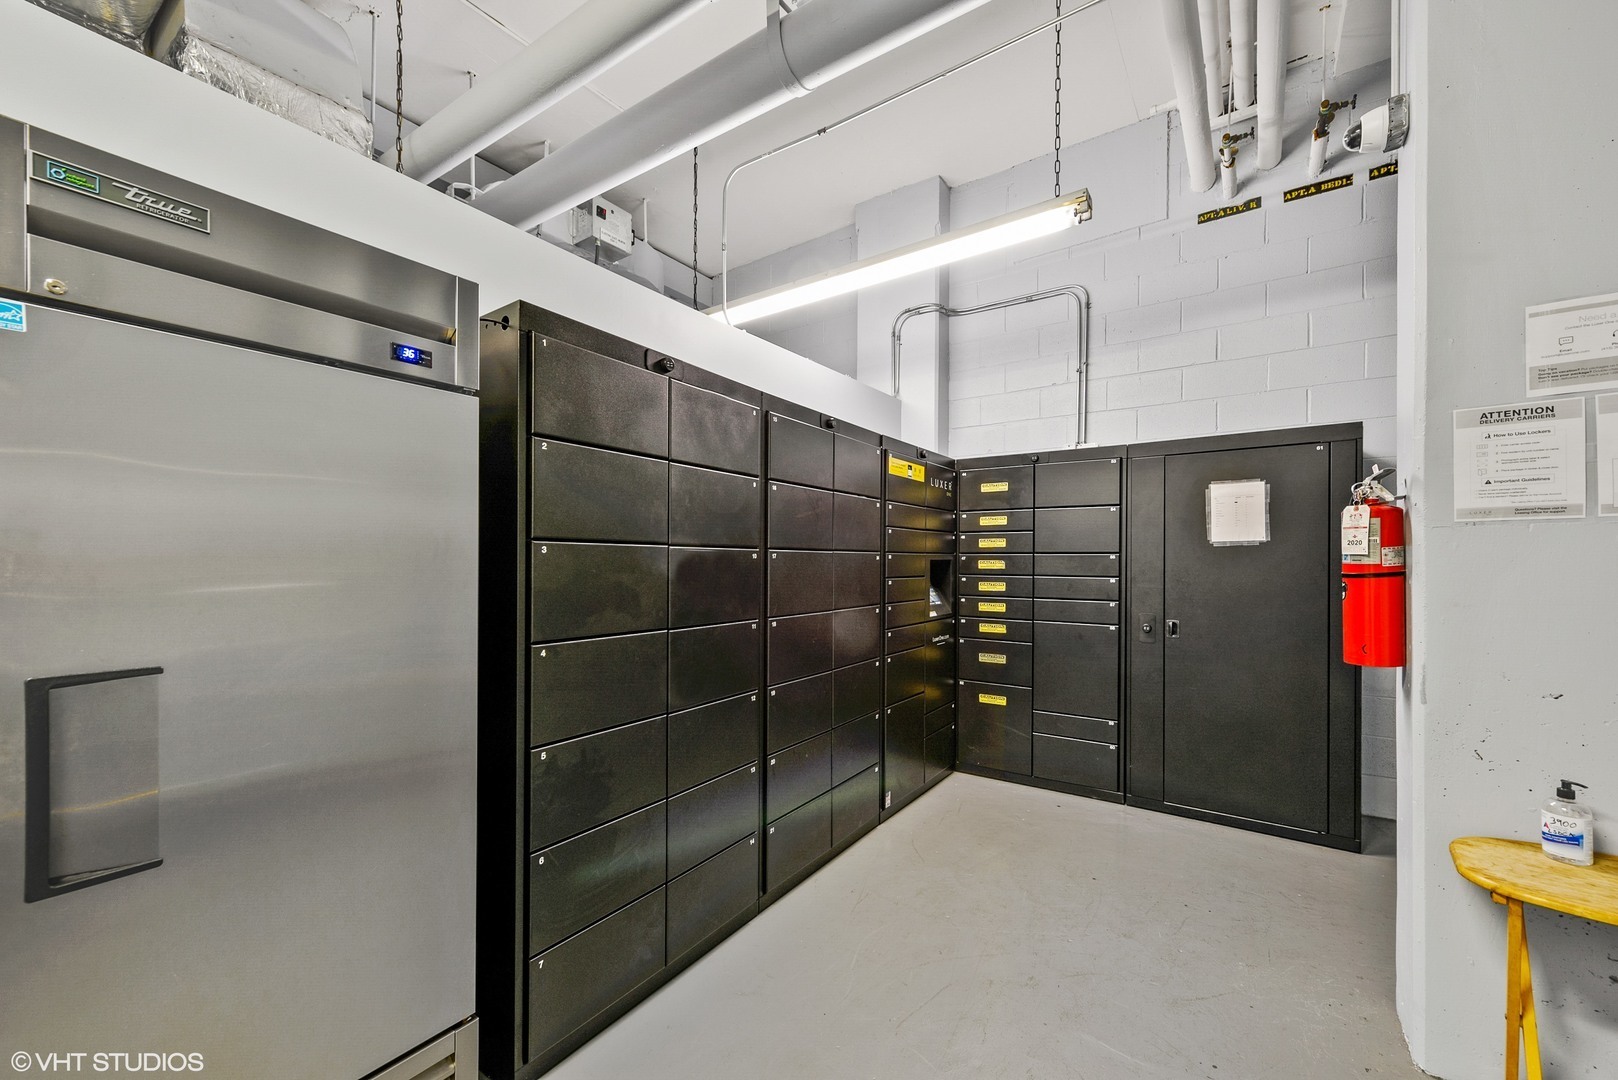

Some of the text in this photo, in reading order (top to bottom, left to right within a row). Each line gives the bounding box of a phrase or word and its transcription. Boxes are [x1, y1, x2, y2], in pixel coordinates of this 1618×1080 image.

[136, 203, 189, 224] REFRIGERATOR
[1578, 312, 1607, 322] Need
[542, 339, 547, 347] 1
[403, 348, 415, 358] 36
[1480, 405, 1555, 420] ATTENTION
[1479, 413, 1556, 425] DELIVERY CARRIERS
[542, 442, 548, 450] 2
[931, 477, 952, 490] LUXER
[540, 649, 546, 657] 4
[540, 752, 547, 760] 5
[1550, 817, 1577, 828] 3900
[538, 857, 544, 865] 6
[538, 960, 544, 969] 7
